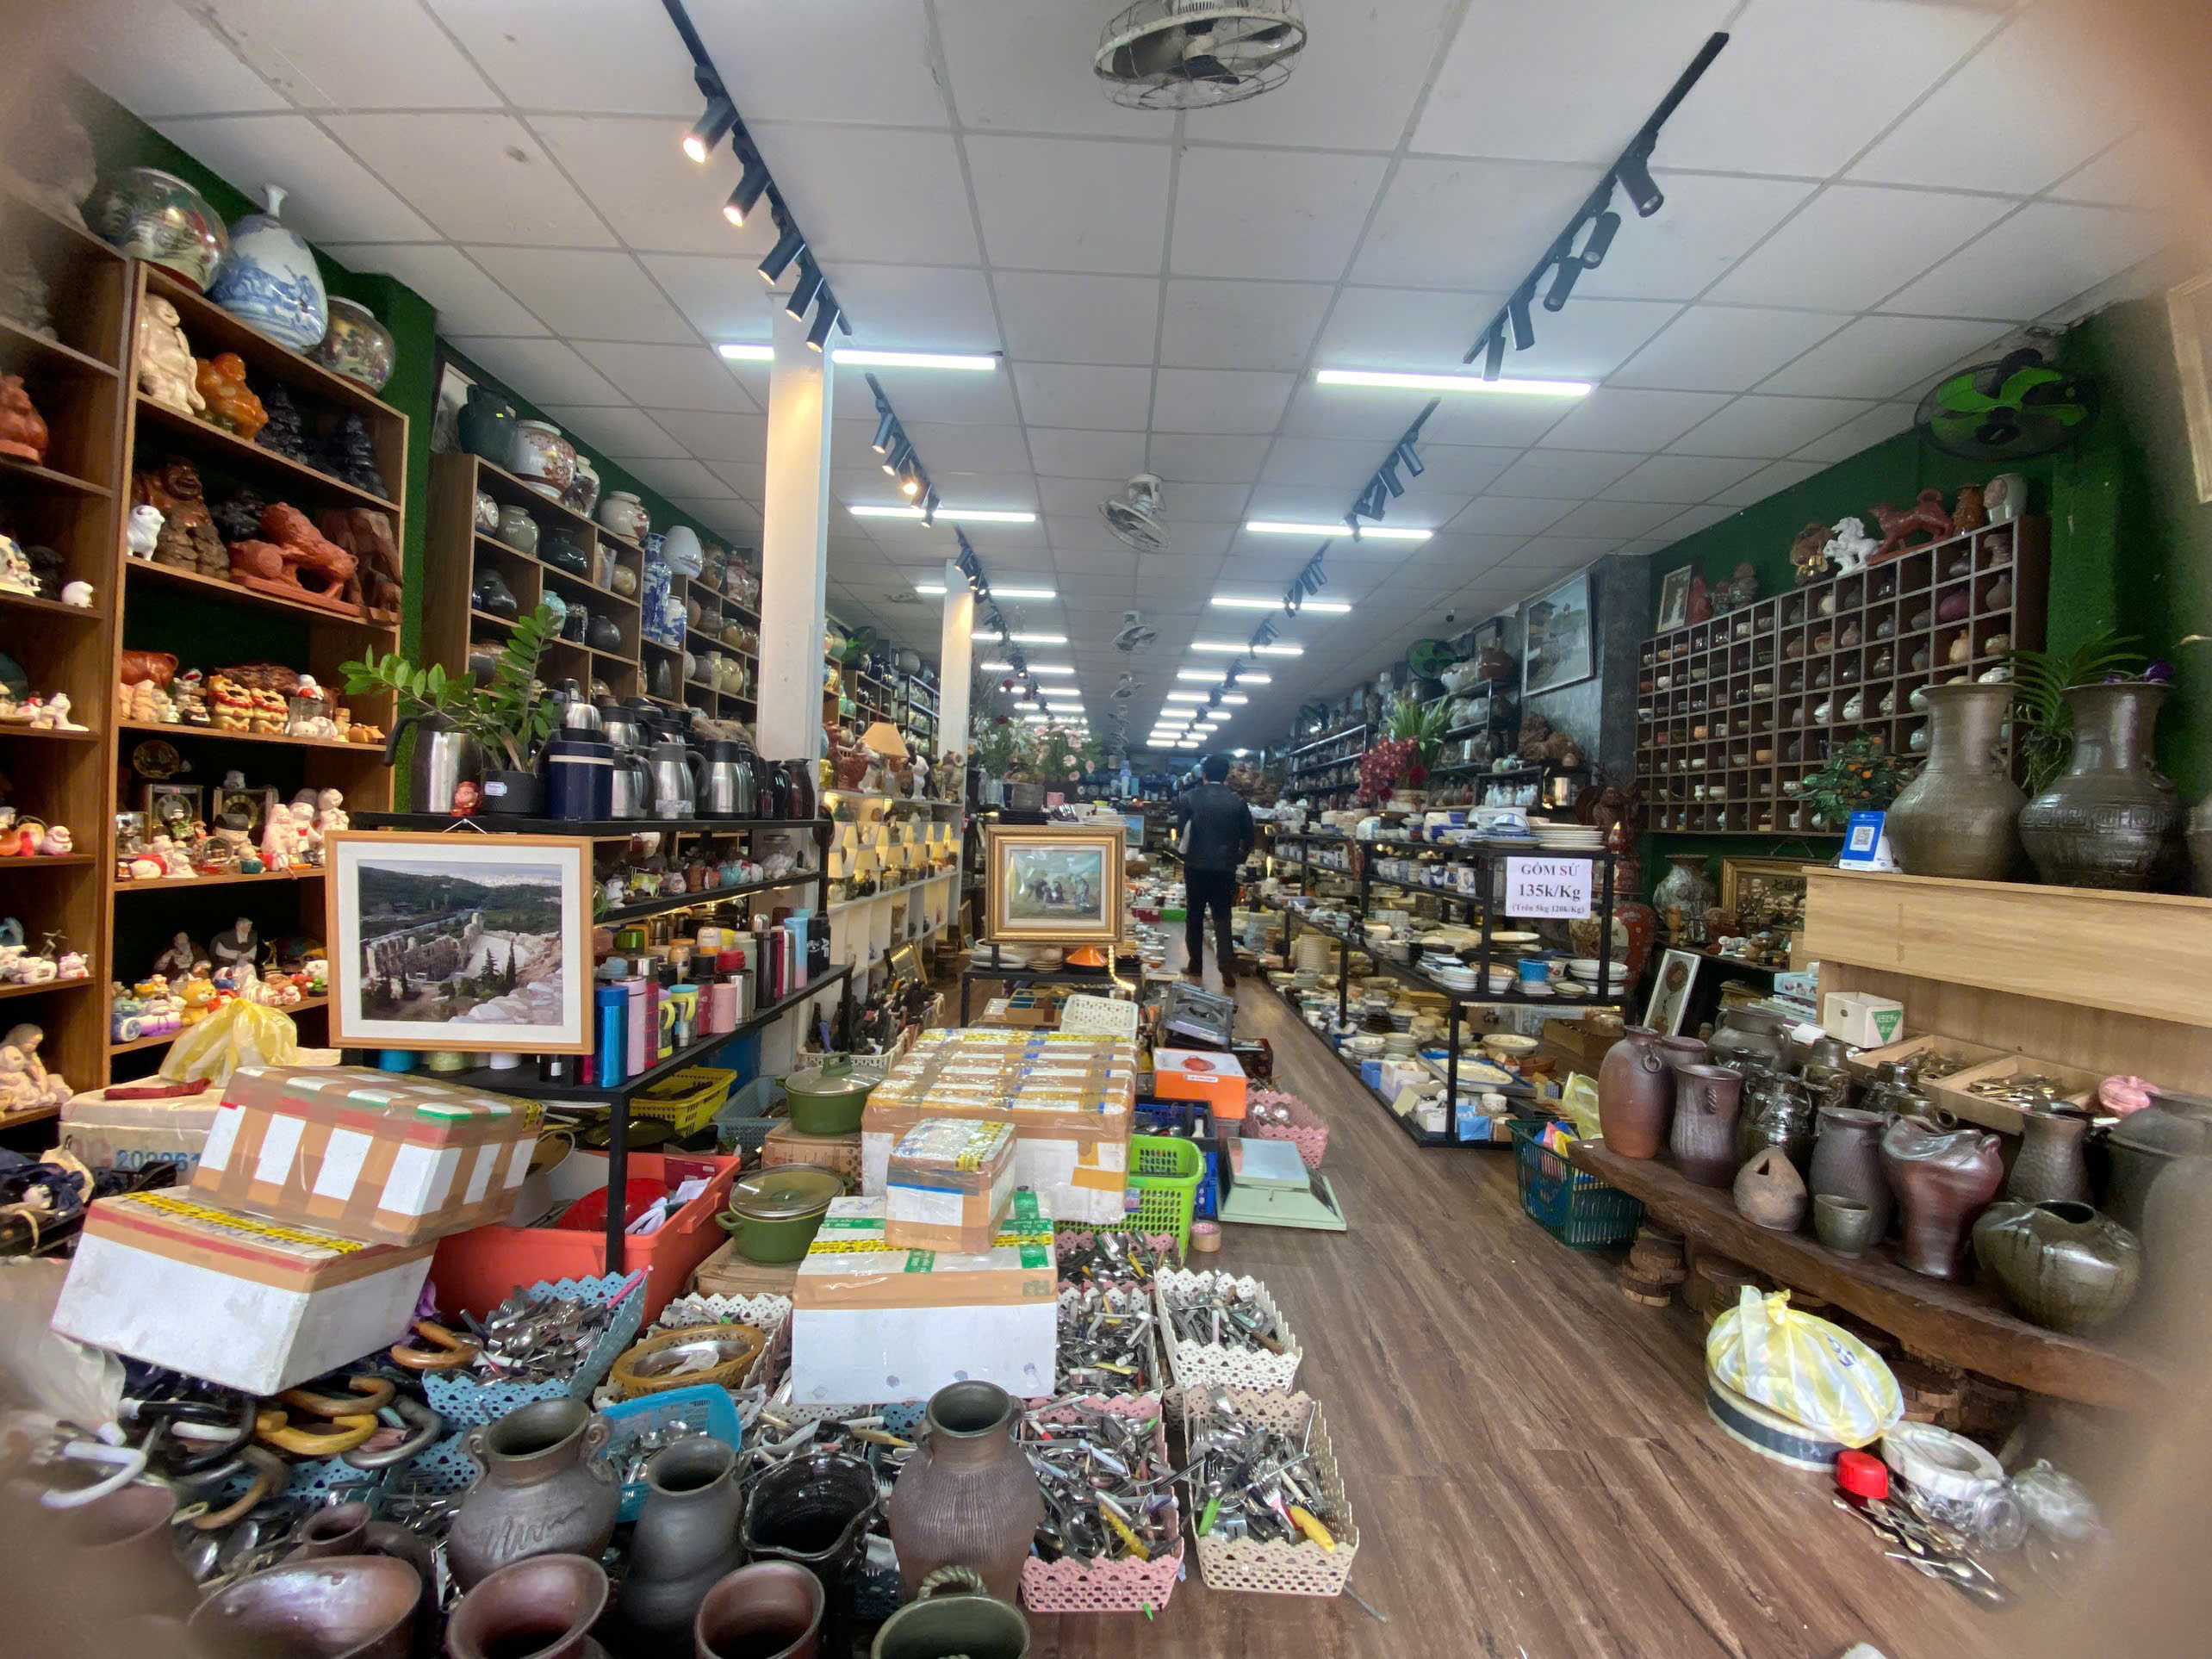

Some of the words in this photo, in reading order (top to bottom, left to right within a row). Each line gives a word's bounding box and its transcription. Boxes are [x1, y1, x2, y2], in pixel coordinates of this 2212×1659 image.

[1560, 862, 1581, 877] SỨ
[1519, 884, 1581, 902] 135k/Kg
[1535, 904, 1550, 914] 5kg
